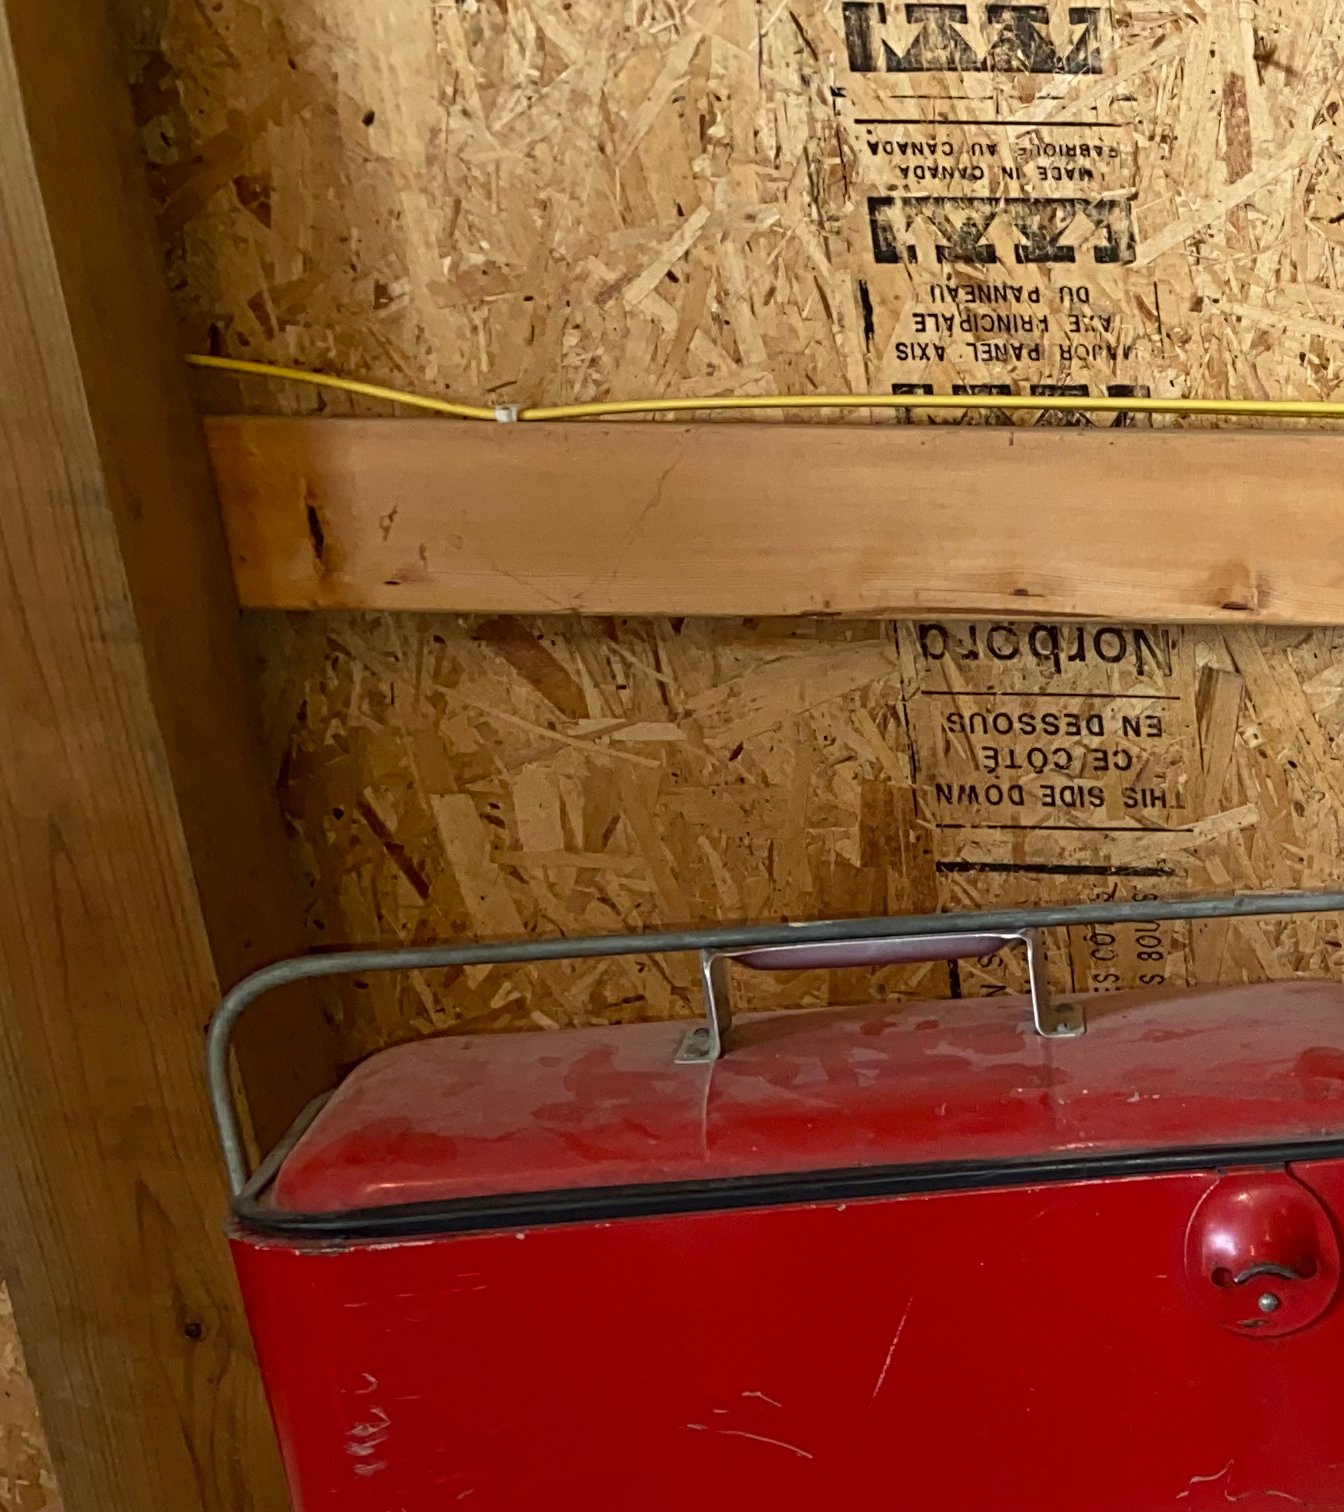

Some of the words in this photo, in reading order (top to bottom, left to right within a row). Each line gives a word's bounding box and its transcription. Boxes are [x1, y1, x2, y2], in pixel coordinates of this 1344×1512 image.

[866, 140, 953, 156] CANADA
[970, 142, 997, 156] AU
[898, 164, 984, 181] CANADA
[1001, 166, 1020, 181] IN
[1037, 165, 1095, 181] MADE
[930, 284, 1040, 303] PANNEAU
[1059, 285, 1089, 303] DU
[911, 313, 1048, 333] PRINCIPALE
[895, 342, 946, 361] AXIS
[967, 342, 1040, 361] PANEL
[945, 712, 1104, 736] DESSOUS
[1121, 715, 1162, 738] EN
[981, 747, 1072, 774] CÔTÉ
[1089, 749, 1132, 771] CE
[934, 783, 1024, 806] DOWN
[1039, 785, 1104, 808] SIDE
[1123, 787, 1186, 809] THIS
